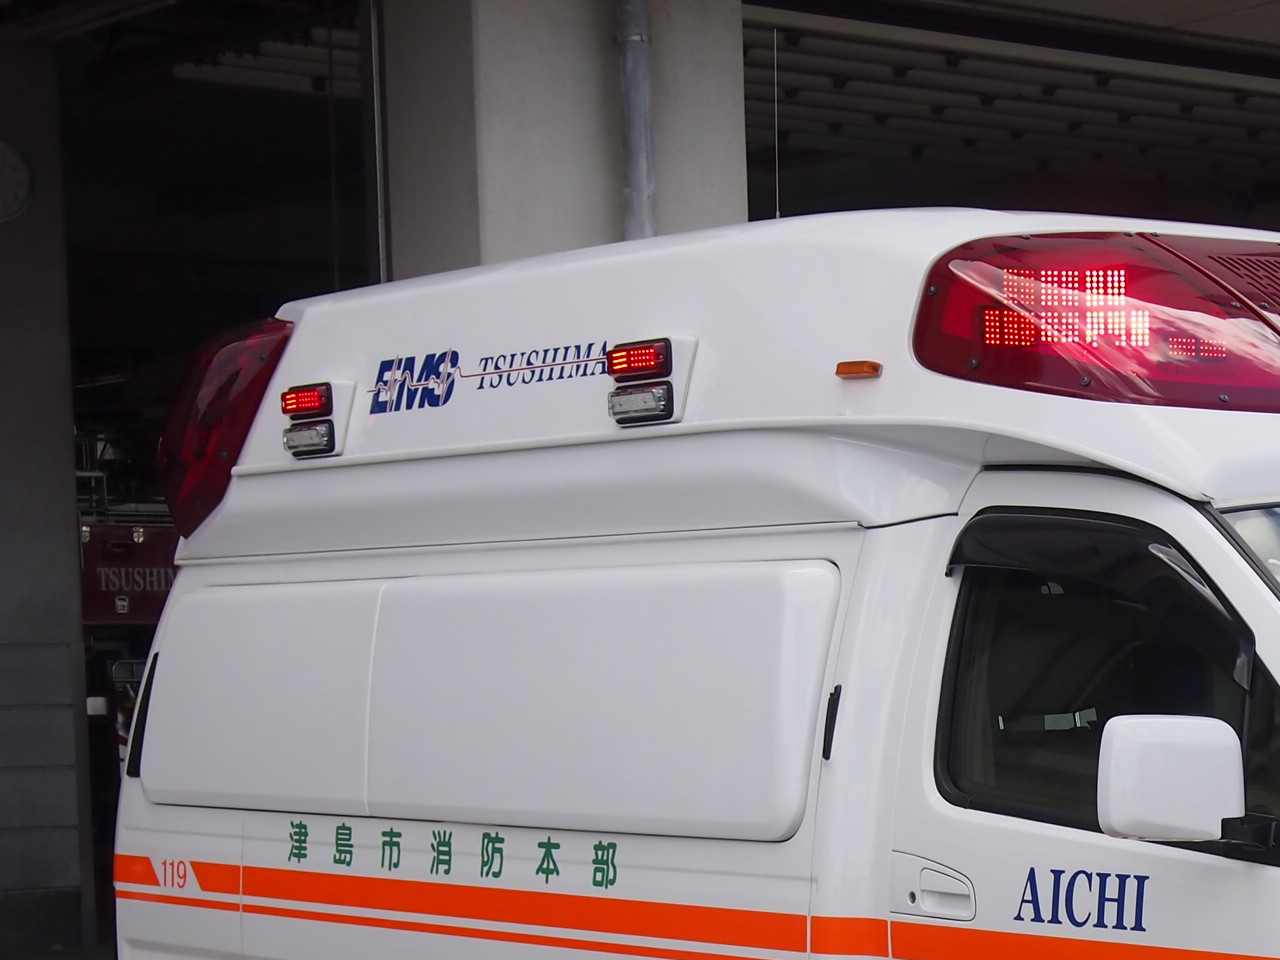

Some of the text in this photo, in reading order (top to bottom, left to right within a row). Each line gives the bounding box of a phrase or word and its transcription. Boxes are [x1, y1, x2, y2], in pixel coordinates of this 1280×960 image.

[369, 341, 608, 414] EMS TSUSHIMA
[161, 859, 187, 889] 119
[288, 820, 618, 889] 津島市消防本部
[1013, 867, 1150, 932] AICHI
